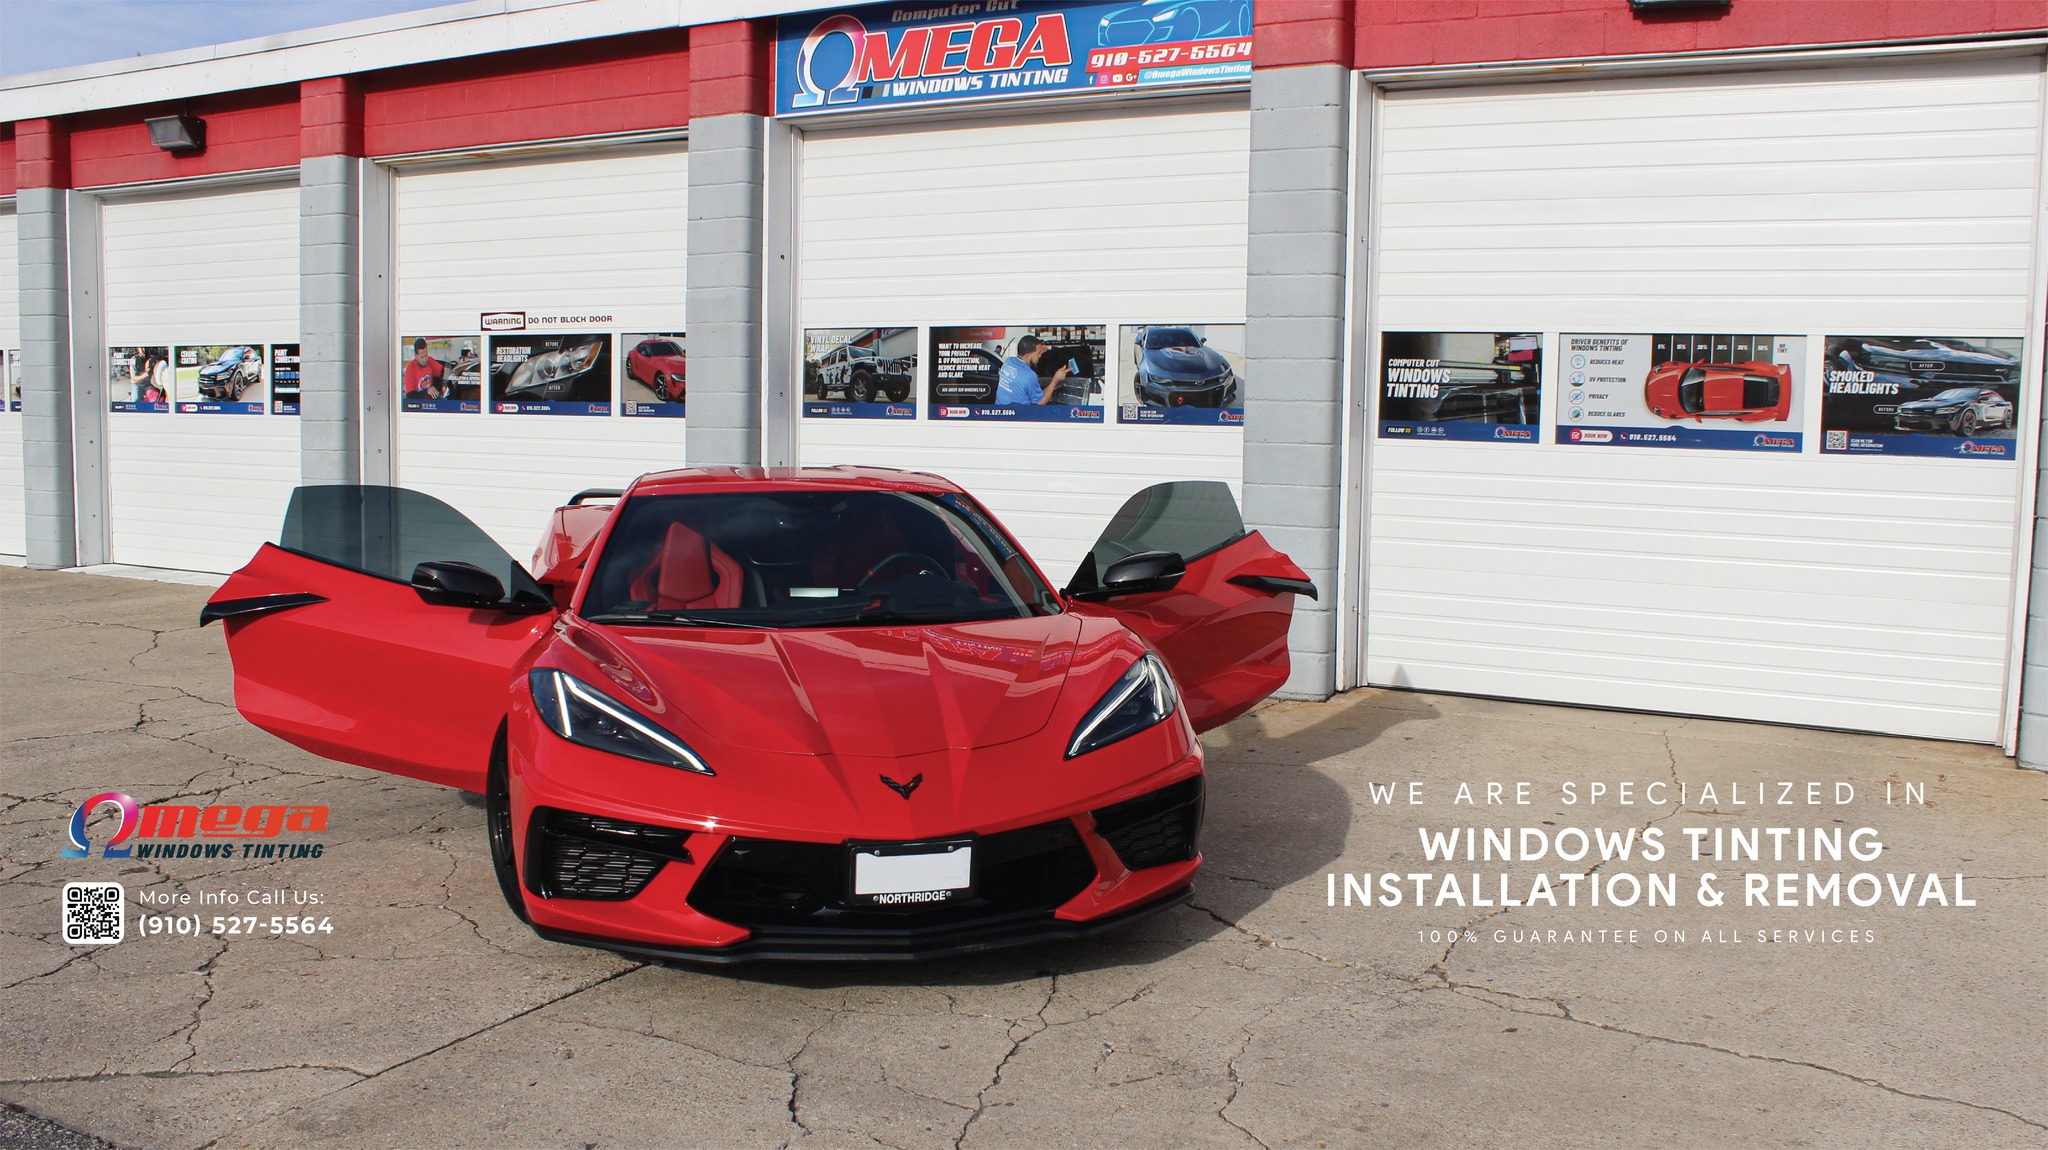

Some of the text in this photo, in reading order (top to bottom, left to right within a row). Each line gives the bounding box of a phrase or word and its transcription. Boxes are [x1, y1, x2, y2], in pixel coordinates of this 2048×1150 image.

[892, 3, 981, 22] Computer
[1091, 42, 1252, 68] 910-527-5564
[892, 68, 1069, 97] WINDOWS TINTING
[485, 317, 522, 325] WARNING
[542, 316, 558, 324] NOT
[589, 315, 613, 323] DOOR
[810, 335, 852, 344] VINYL DECAL
[810, 344, 830, 353] WRAP
[1388, 358, 1441, 367] COMPUTER CUT
[1387, 368, 1452, 384] WINDOWS
[1829, 370, 1875, 383] SMOKED
[1386, 383, 1440, 398] TINTING
[1829, 382, 1900, 395] HEADLIGHTS
[879, 890, 946, 904] NORTHRIDGE
